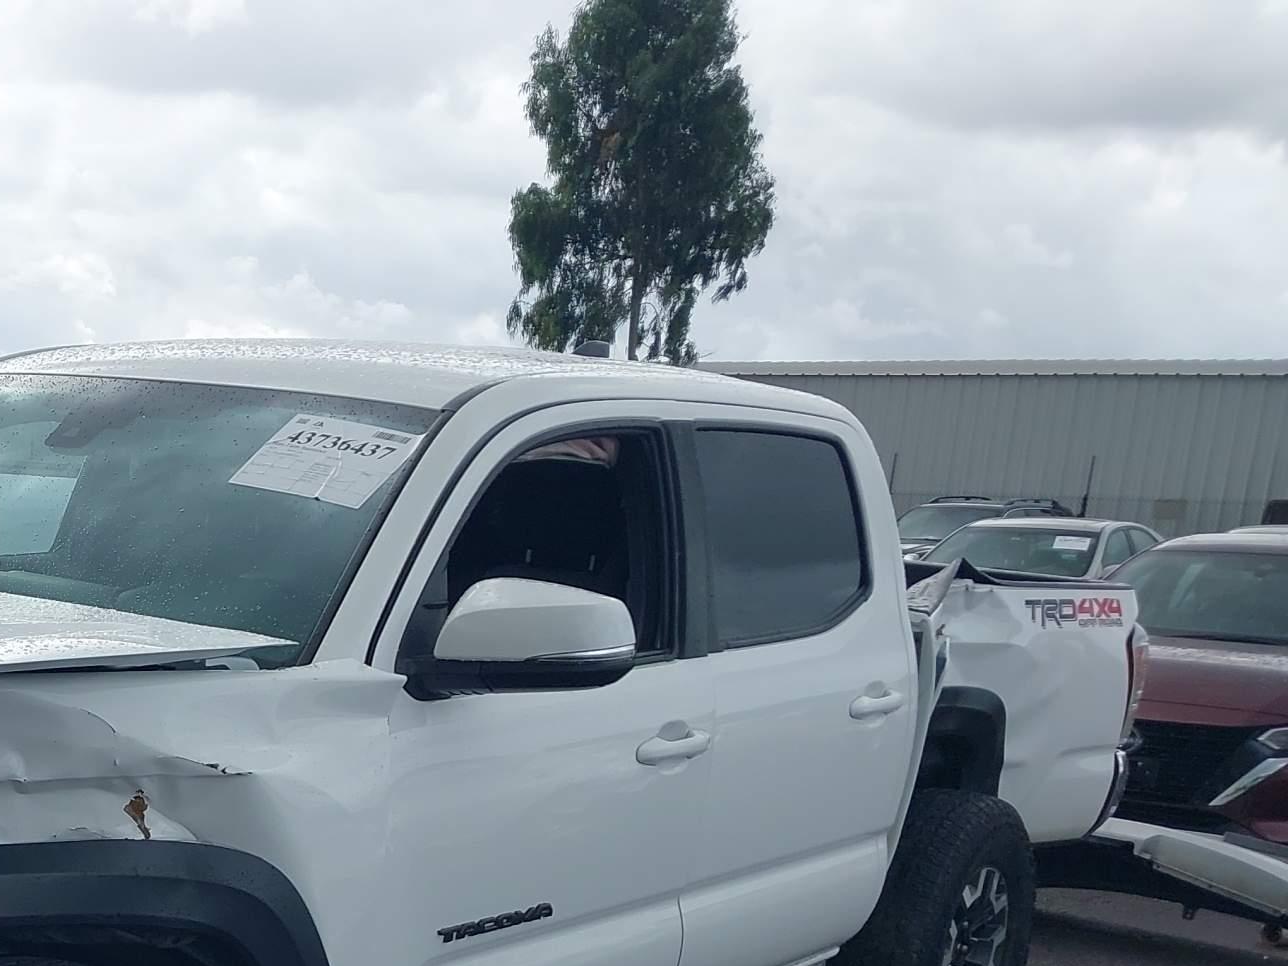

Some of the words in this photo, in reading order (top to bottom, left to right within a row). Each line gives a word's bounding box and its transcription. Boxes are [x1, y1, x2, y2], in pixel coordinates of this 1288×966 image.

[288, 430, 397, 459] 43736437
[1024, 598, 1077, 629] TRD
[437, 902, 553, 943] TACOMA
